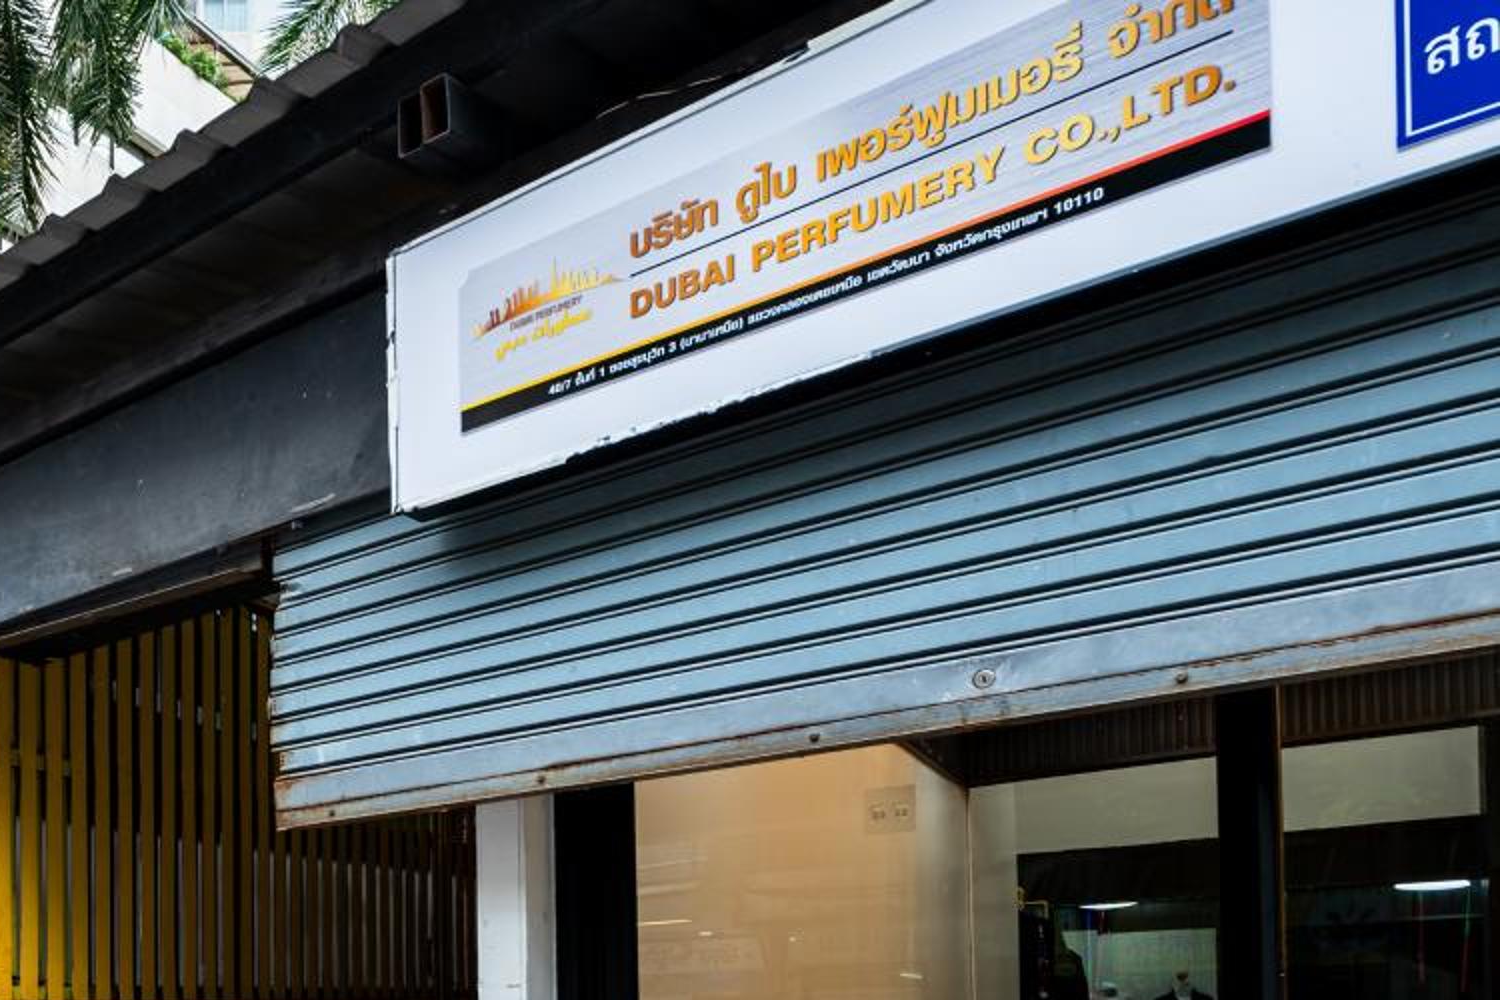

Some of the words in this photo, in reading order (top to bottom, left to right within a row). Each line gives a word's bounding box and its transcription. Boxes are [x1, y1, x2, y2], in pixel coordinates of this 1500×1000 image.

[629, 253, 736, 319] DUBAI
[752, 144, 1006, 272] PERFUMERY
[1022, 64, 1237, 165] CO.,LTD.
[629, 197, 719, 259] บริษัท
[735, 160, 797, 224] ดูไบ
[1054, 187, 1105, 217] 10110
